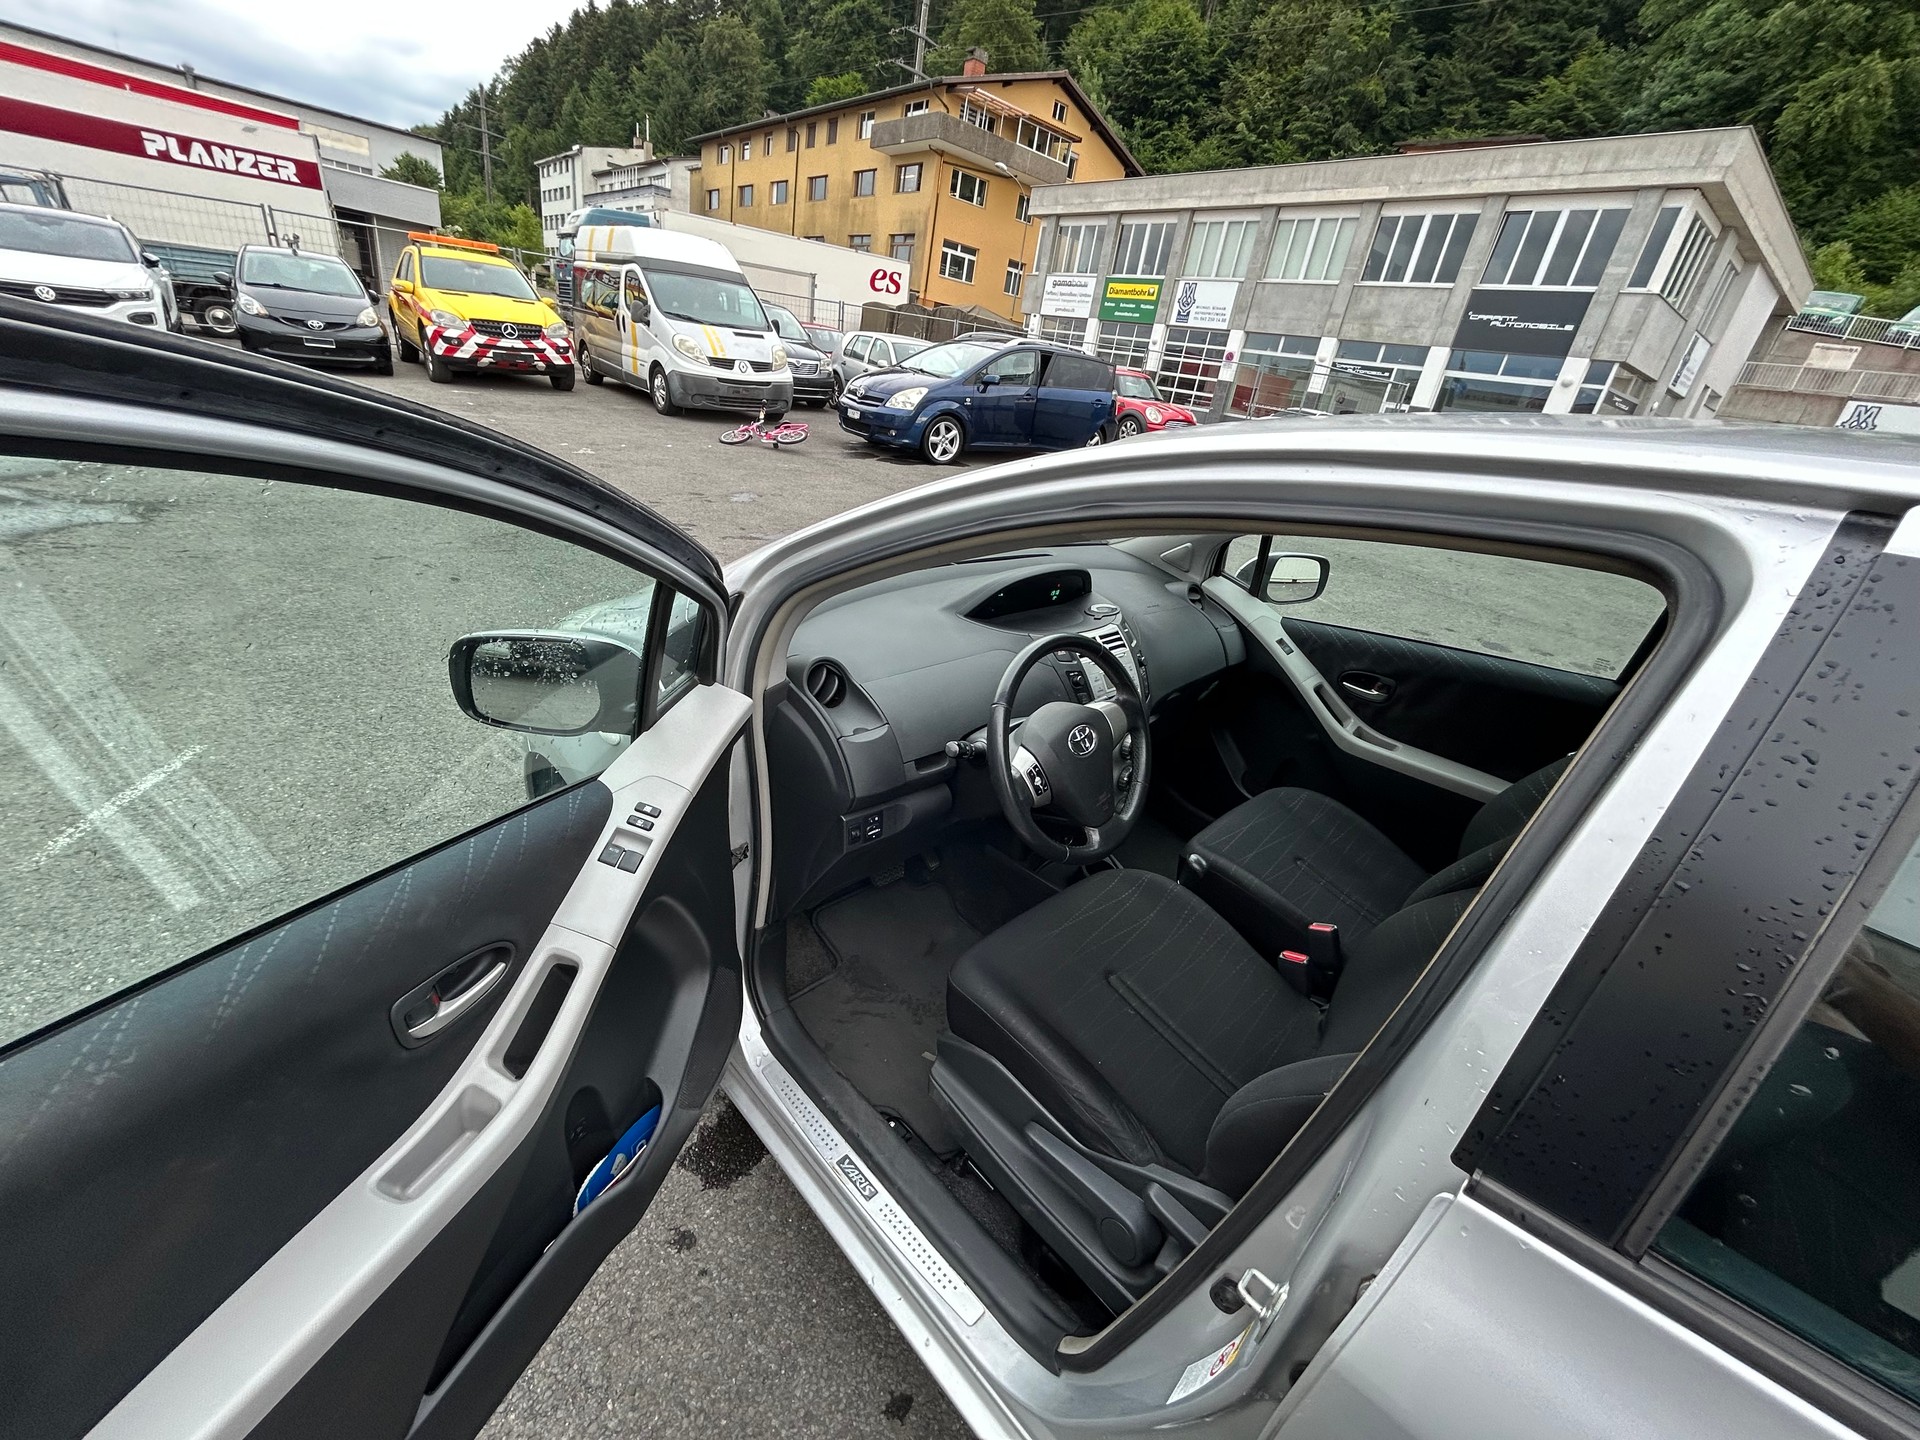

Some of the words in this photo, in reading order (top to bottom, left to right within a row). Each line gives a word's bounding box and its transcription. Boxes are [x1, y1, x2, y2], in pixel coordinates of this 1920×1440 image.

[140, 130, 301, 184] PLANZER
[869, 268, 902, 295] es
[1109, 286, 1148, 296] Diamantbohr
[841, 1158, 875, 1196] YARIS
